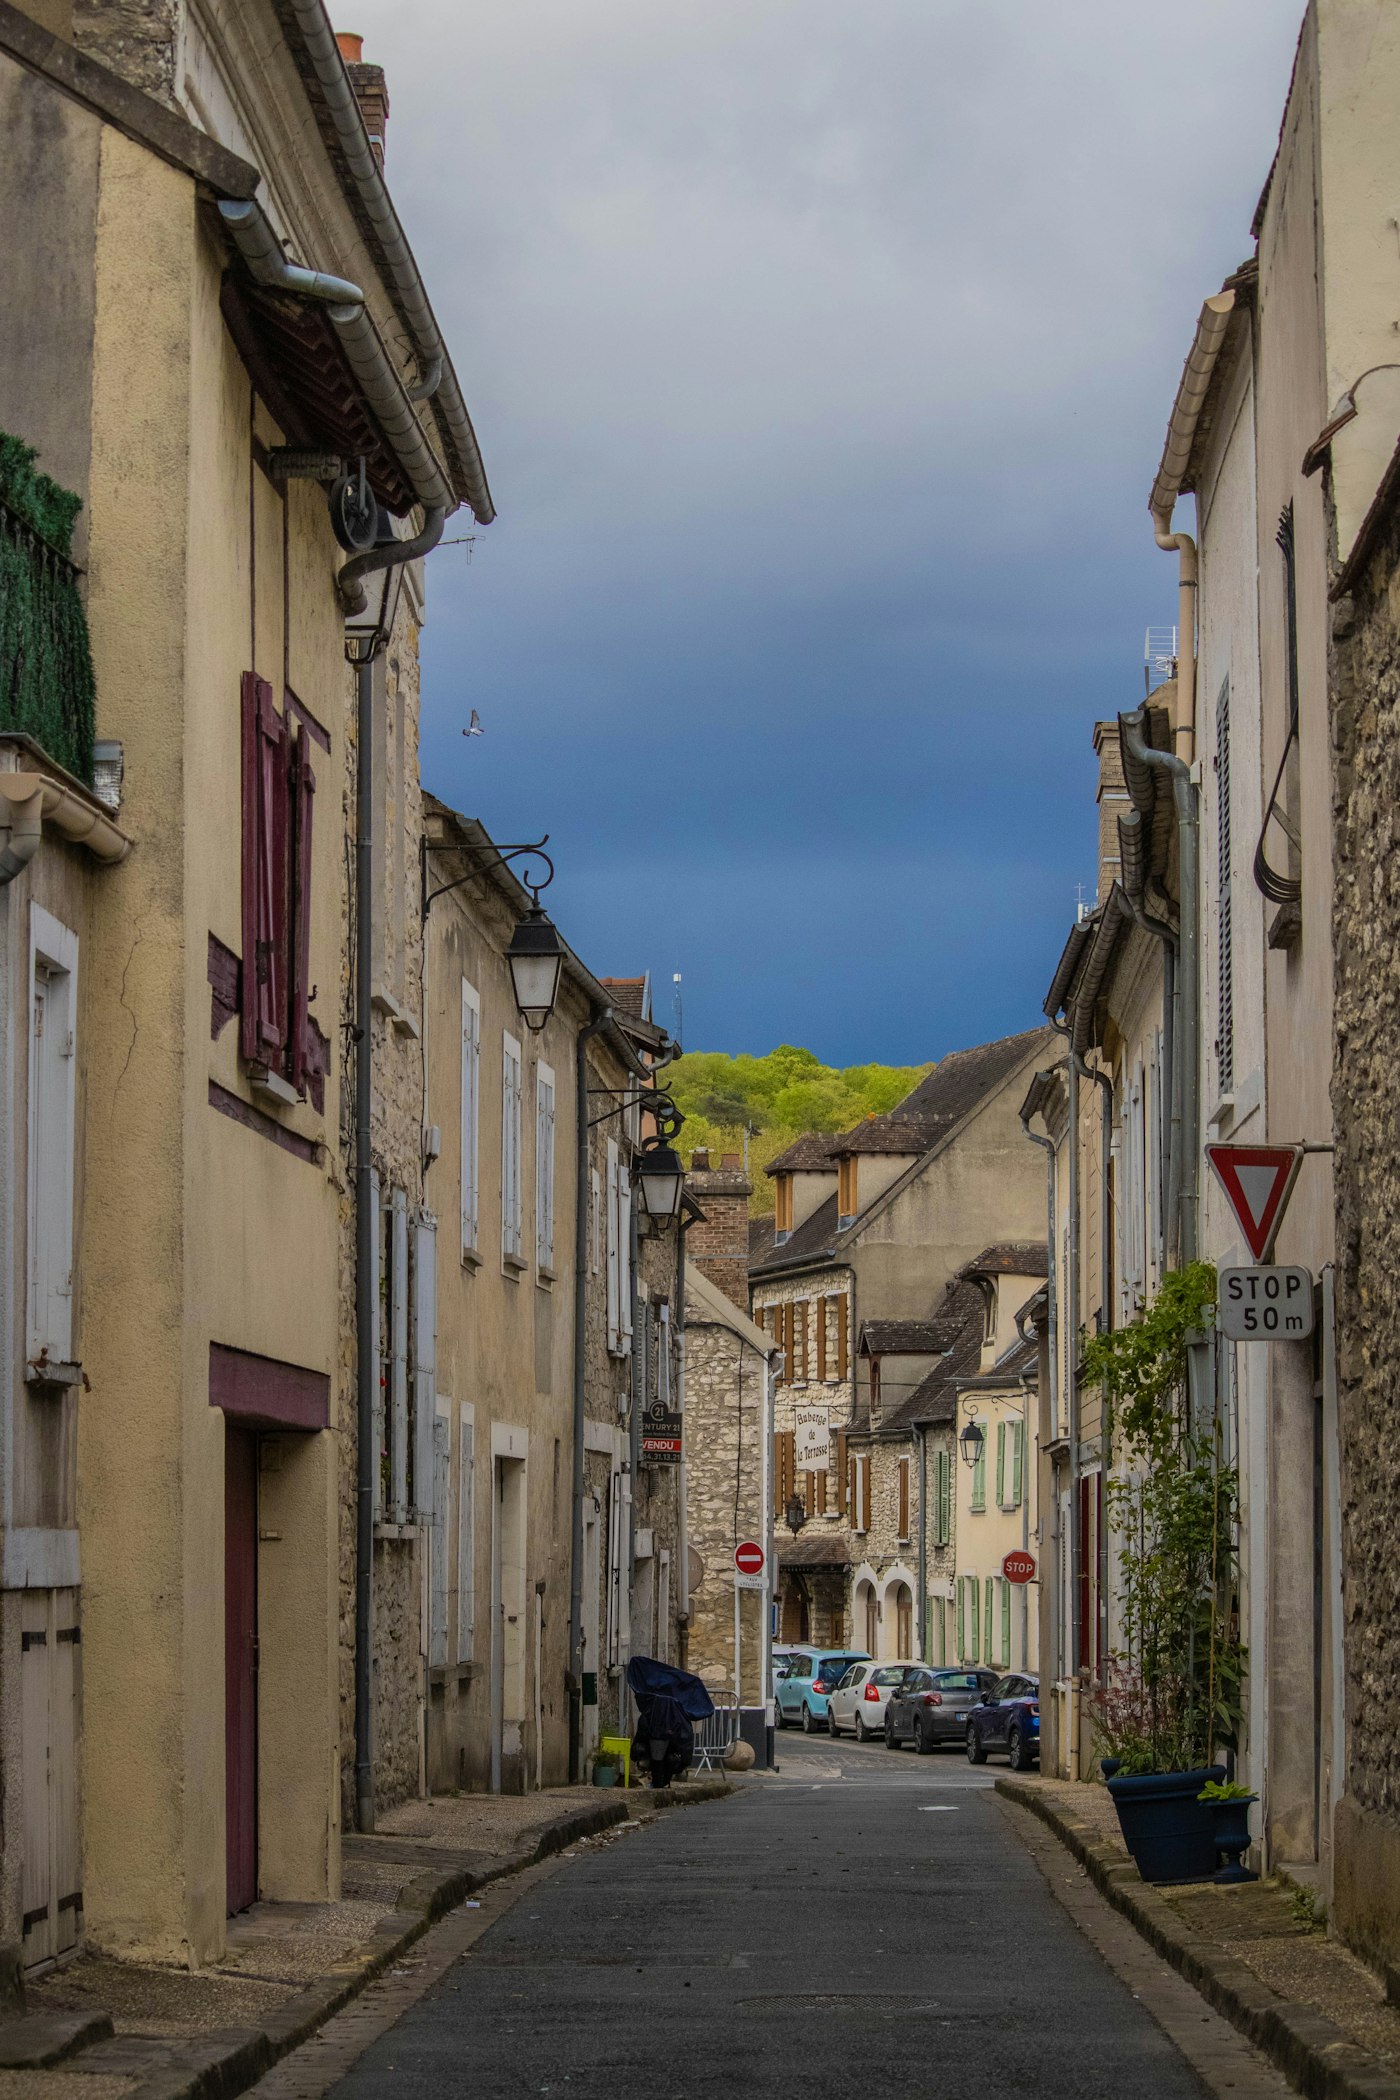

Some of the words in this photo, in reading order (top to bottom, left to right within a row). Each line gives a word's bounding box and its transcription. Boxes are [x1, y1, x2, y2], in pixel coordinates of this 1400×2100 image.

[1228, 1275, 1301, 1300] STOP
[797, 1412, 827, 1426] Auberge
[641, 1423, 671, 1431] ENTURY
[672, 1424, 680, 1432] 21
[808, 1429, 816, 1440] de
[804, 1445, 828, 1461] Terrasse
[1006, 1562, 1033, 1573] STOP
